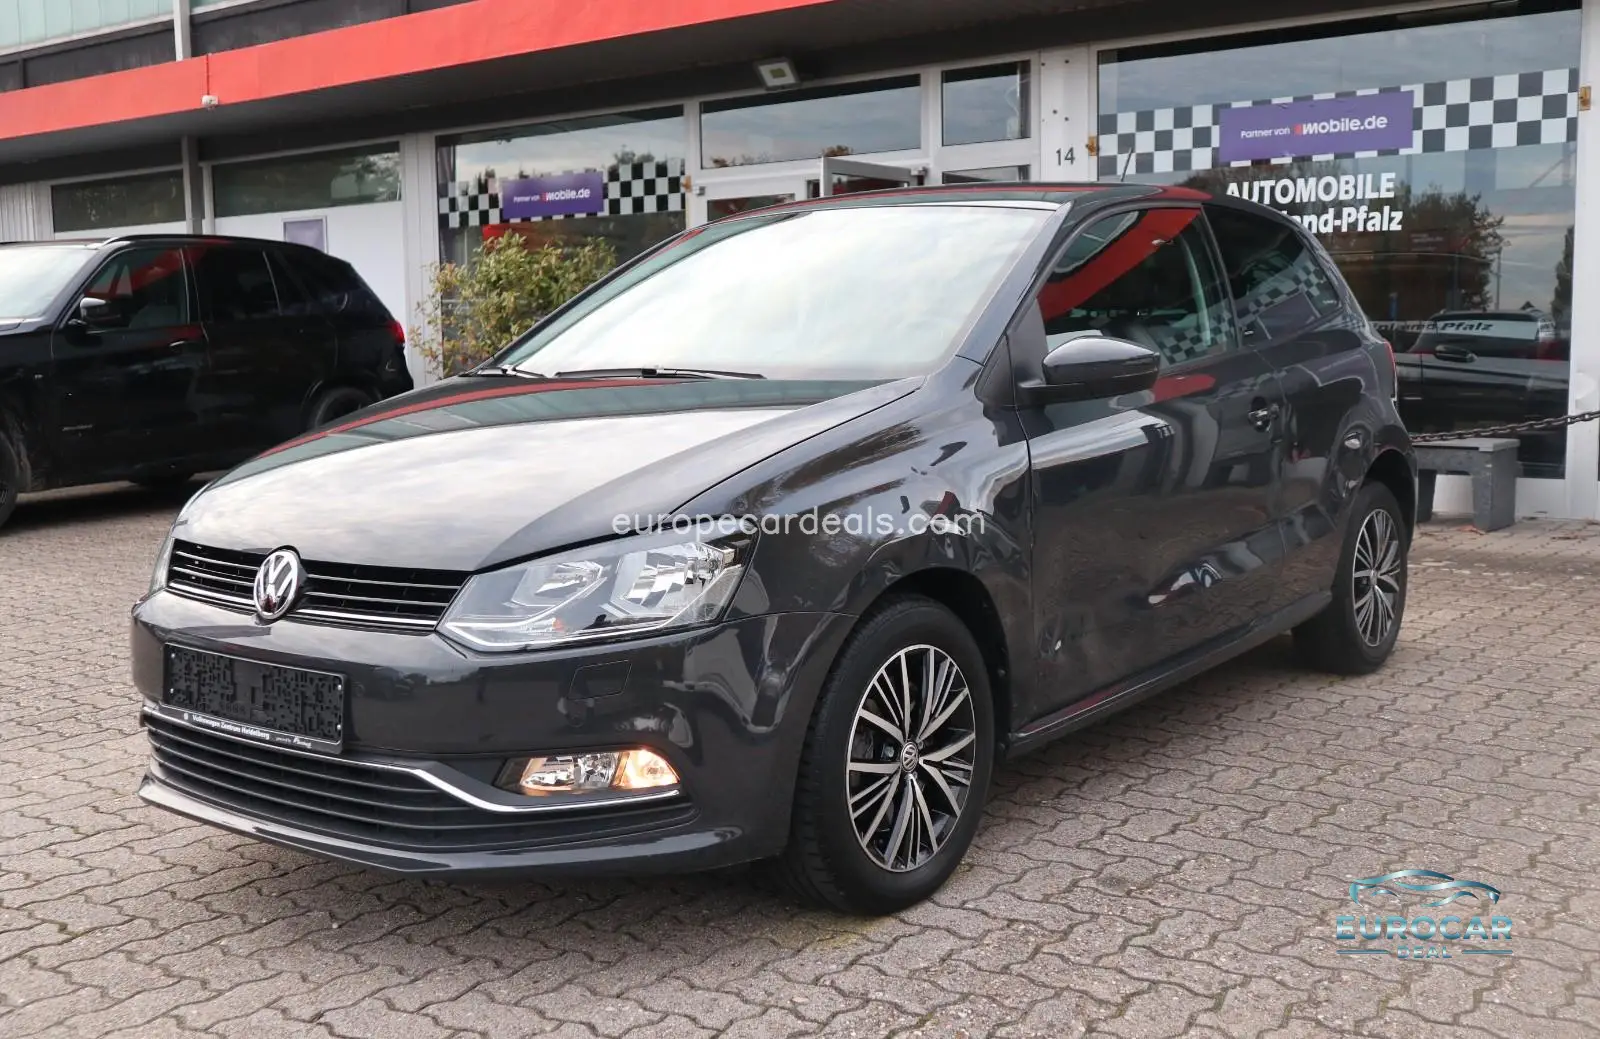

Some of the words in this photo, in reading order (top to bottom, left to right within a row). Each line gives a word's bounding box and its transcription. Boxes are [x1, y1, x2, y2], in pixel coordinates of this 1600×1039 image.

[1240, 129, 1272, 139] Partner
[1274, 127, 1291, 136] von
[1301, 115, 1388, 135] mobile.de
[1056, 147, 1076, 166] 14
[545, 188, 591, 202] mobile.de
[1226, 172, 1396, 205] AUTOMOBILE
[192, 714, 221, 729] Volkswagen
[241, 726, 270, 740] Heidelberg
